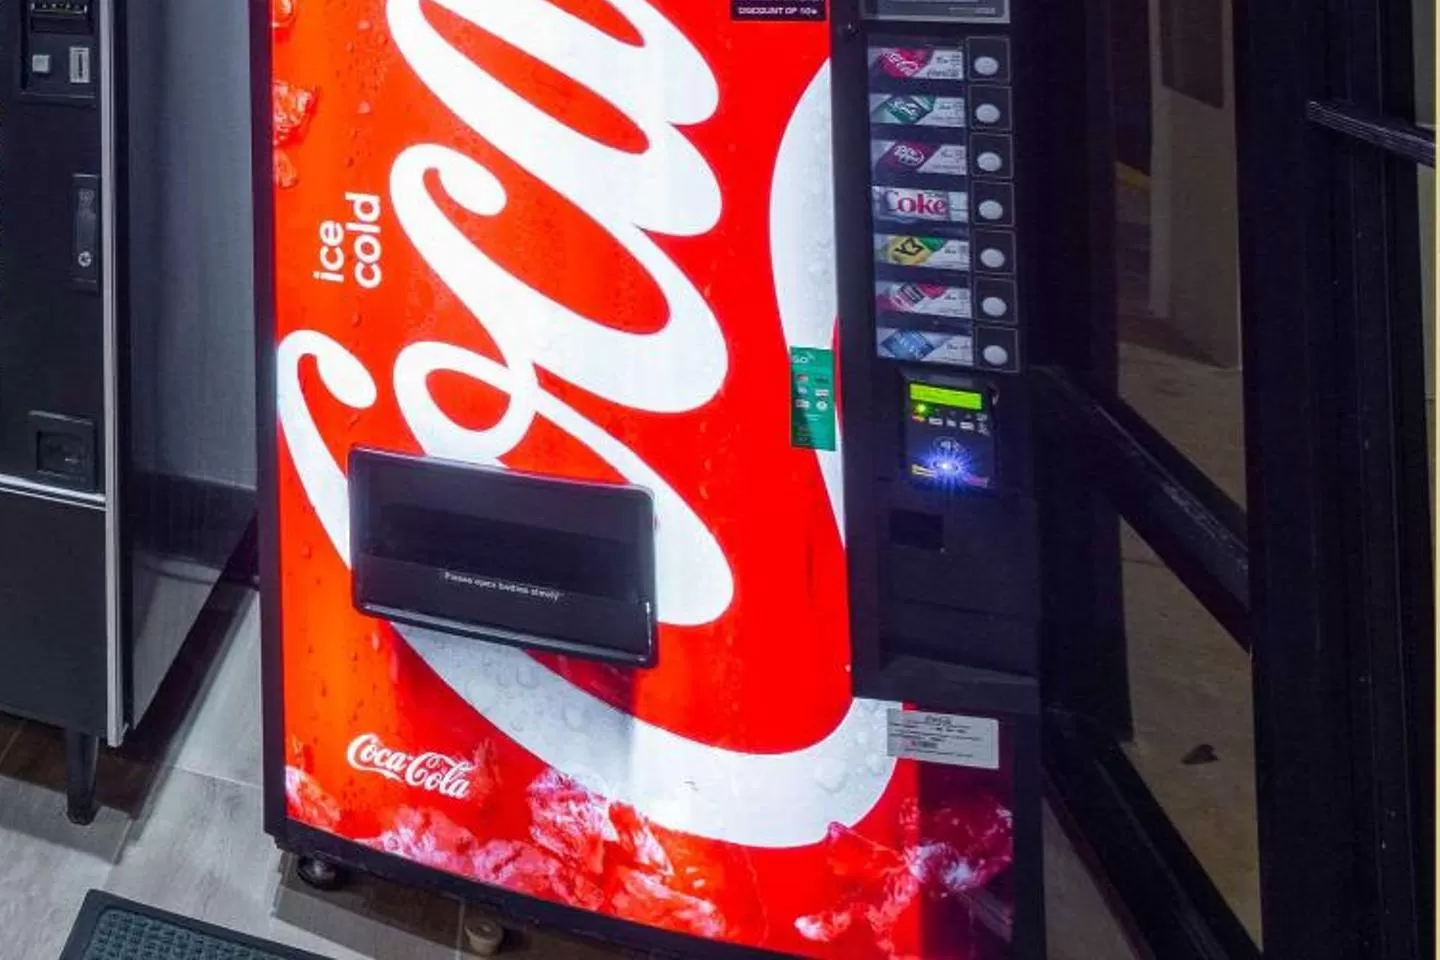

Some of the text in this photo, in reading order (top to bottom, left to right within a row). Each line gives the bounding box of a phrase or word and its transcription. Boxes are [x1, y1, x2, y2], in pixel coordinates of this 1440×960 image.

[312, 220, 344, 283] ice
[344, 191, 382, 288] cold
[346, 732, 477, 800] Coca-Cola
